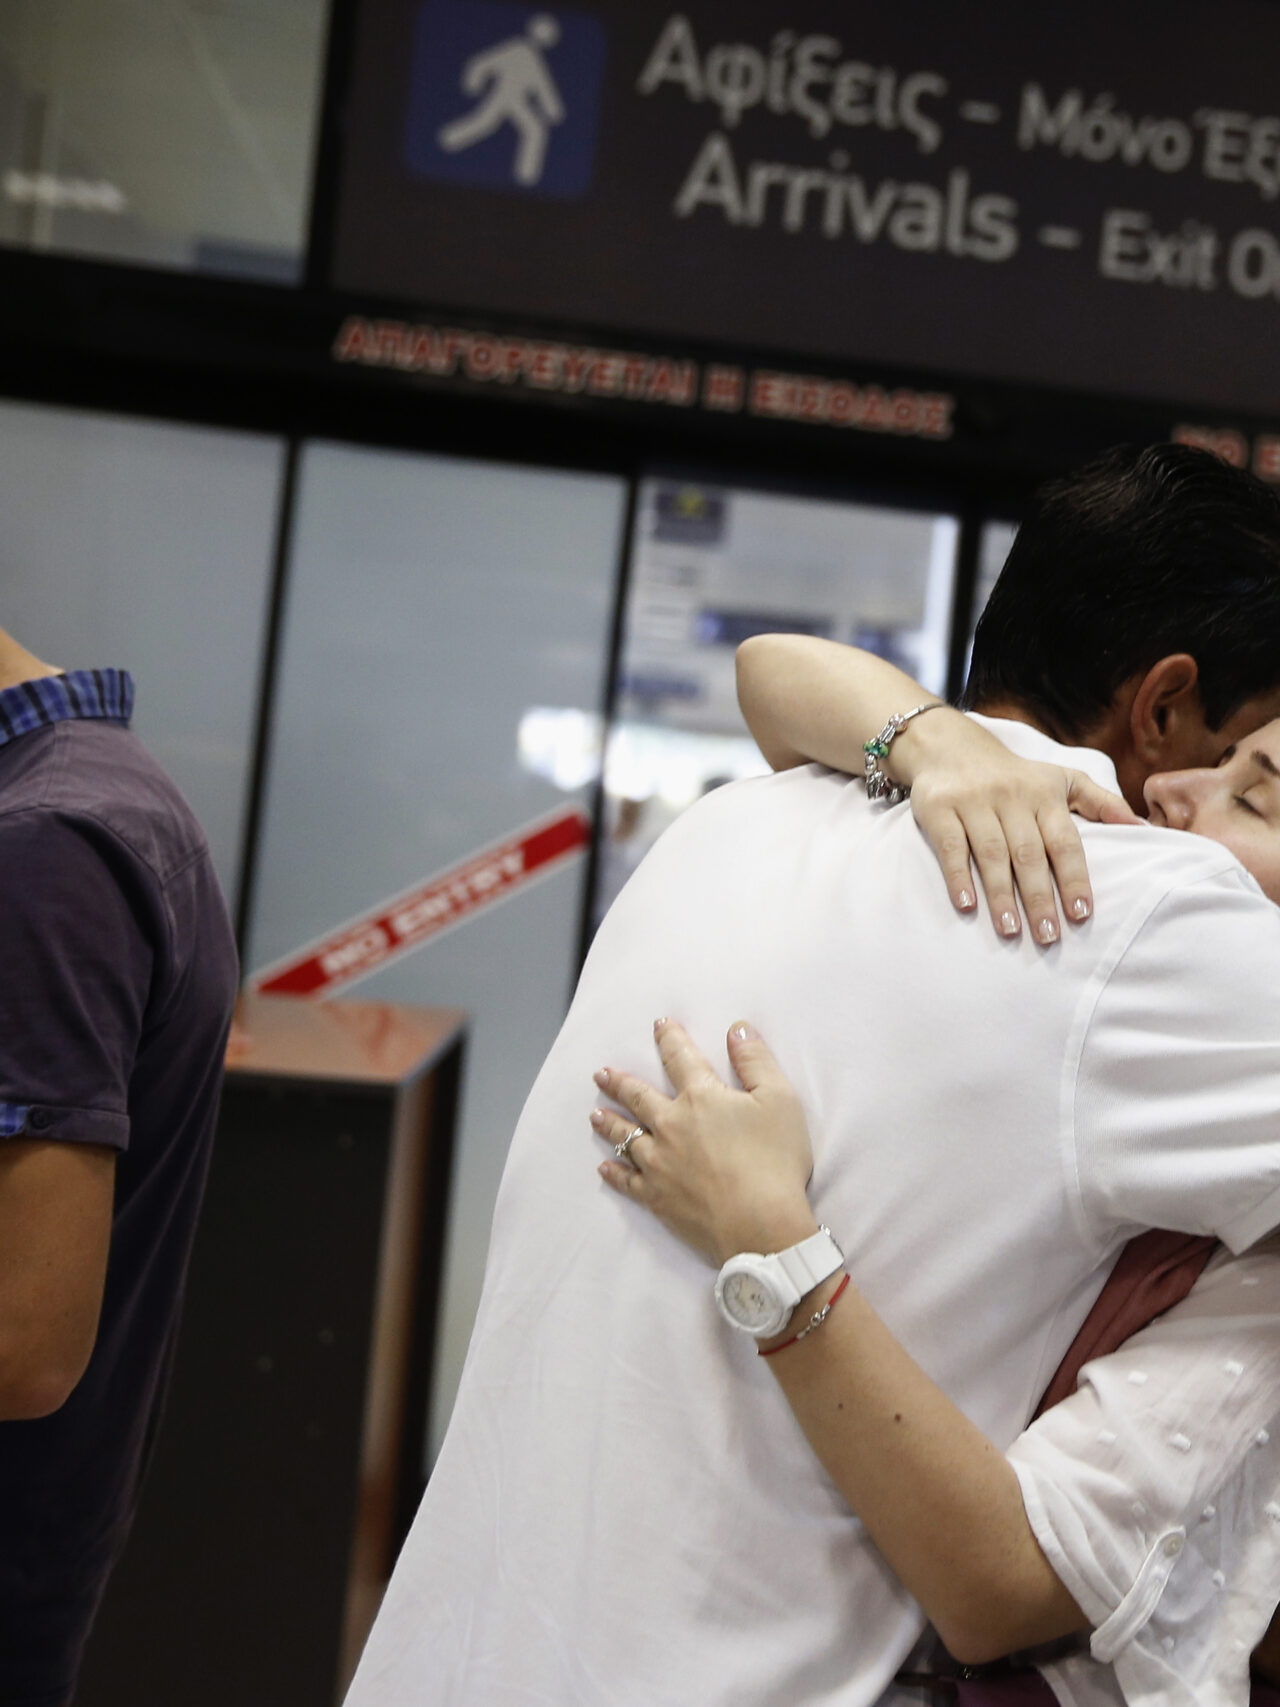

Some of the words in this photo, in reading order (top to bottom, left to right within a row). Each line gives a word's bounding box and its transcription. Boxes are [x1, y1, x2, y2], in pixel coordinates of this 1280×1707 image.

[640, 14, 949, 152] Αφίξεις
[1019, 84, 1192, 171] Μόνο
[676, 132, 1020, 260] Arrivals
[1100, 209, 1216, 290] Exit
[334, 316, 695, 405] ΑΠΑΓΟΡΕΥΕΤΑΙ
[318, 918, 392, 976] NO
[390, 847, 527, 938] ENTRY
